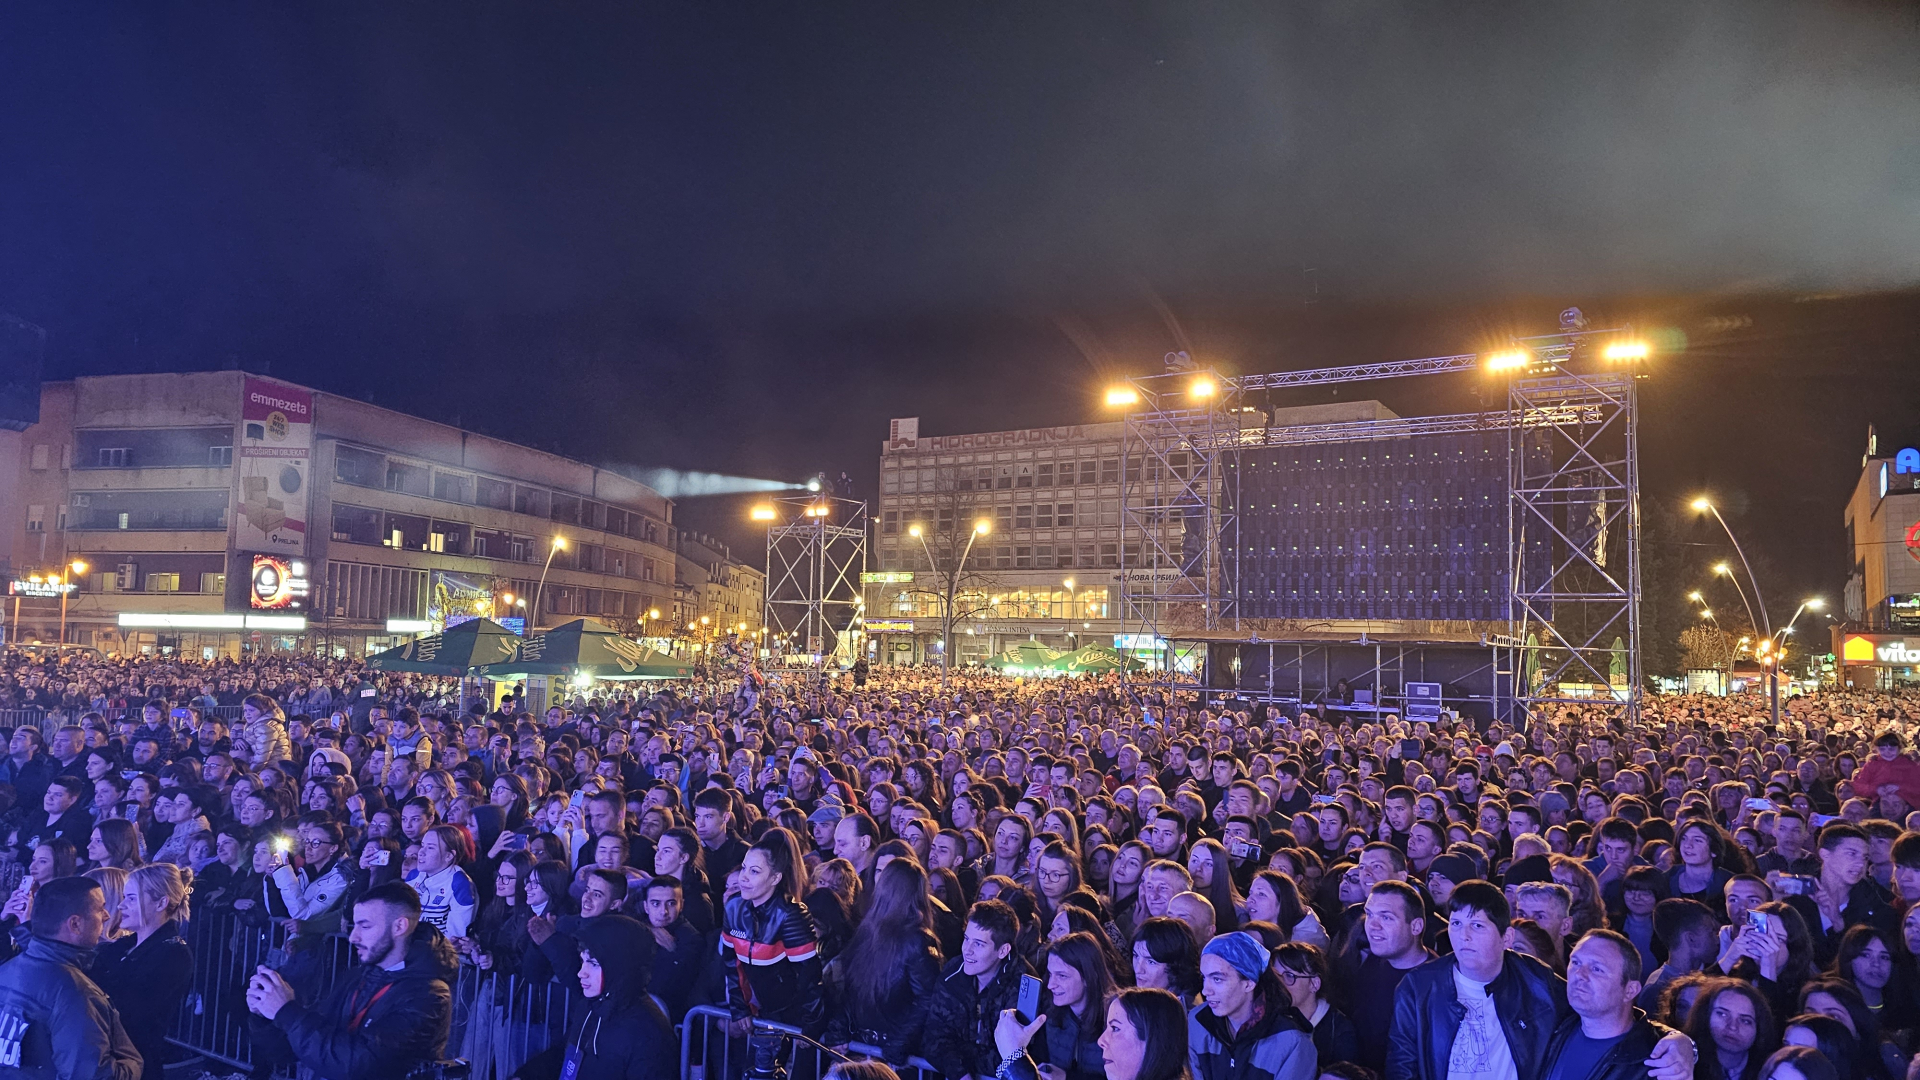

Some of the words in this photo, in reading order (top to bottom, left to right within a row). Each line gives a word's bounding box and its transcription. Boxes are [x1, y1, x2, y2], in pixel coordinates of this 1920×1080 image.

[250, 392, 307, 414] emmezeta
[931, 426, 1085, 449] HIDROGRADNJA
[245, 447, 279, 456] PROŠIRENI
[1138, 636, 1152, 647] lilly
